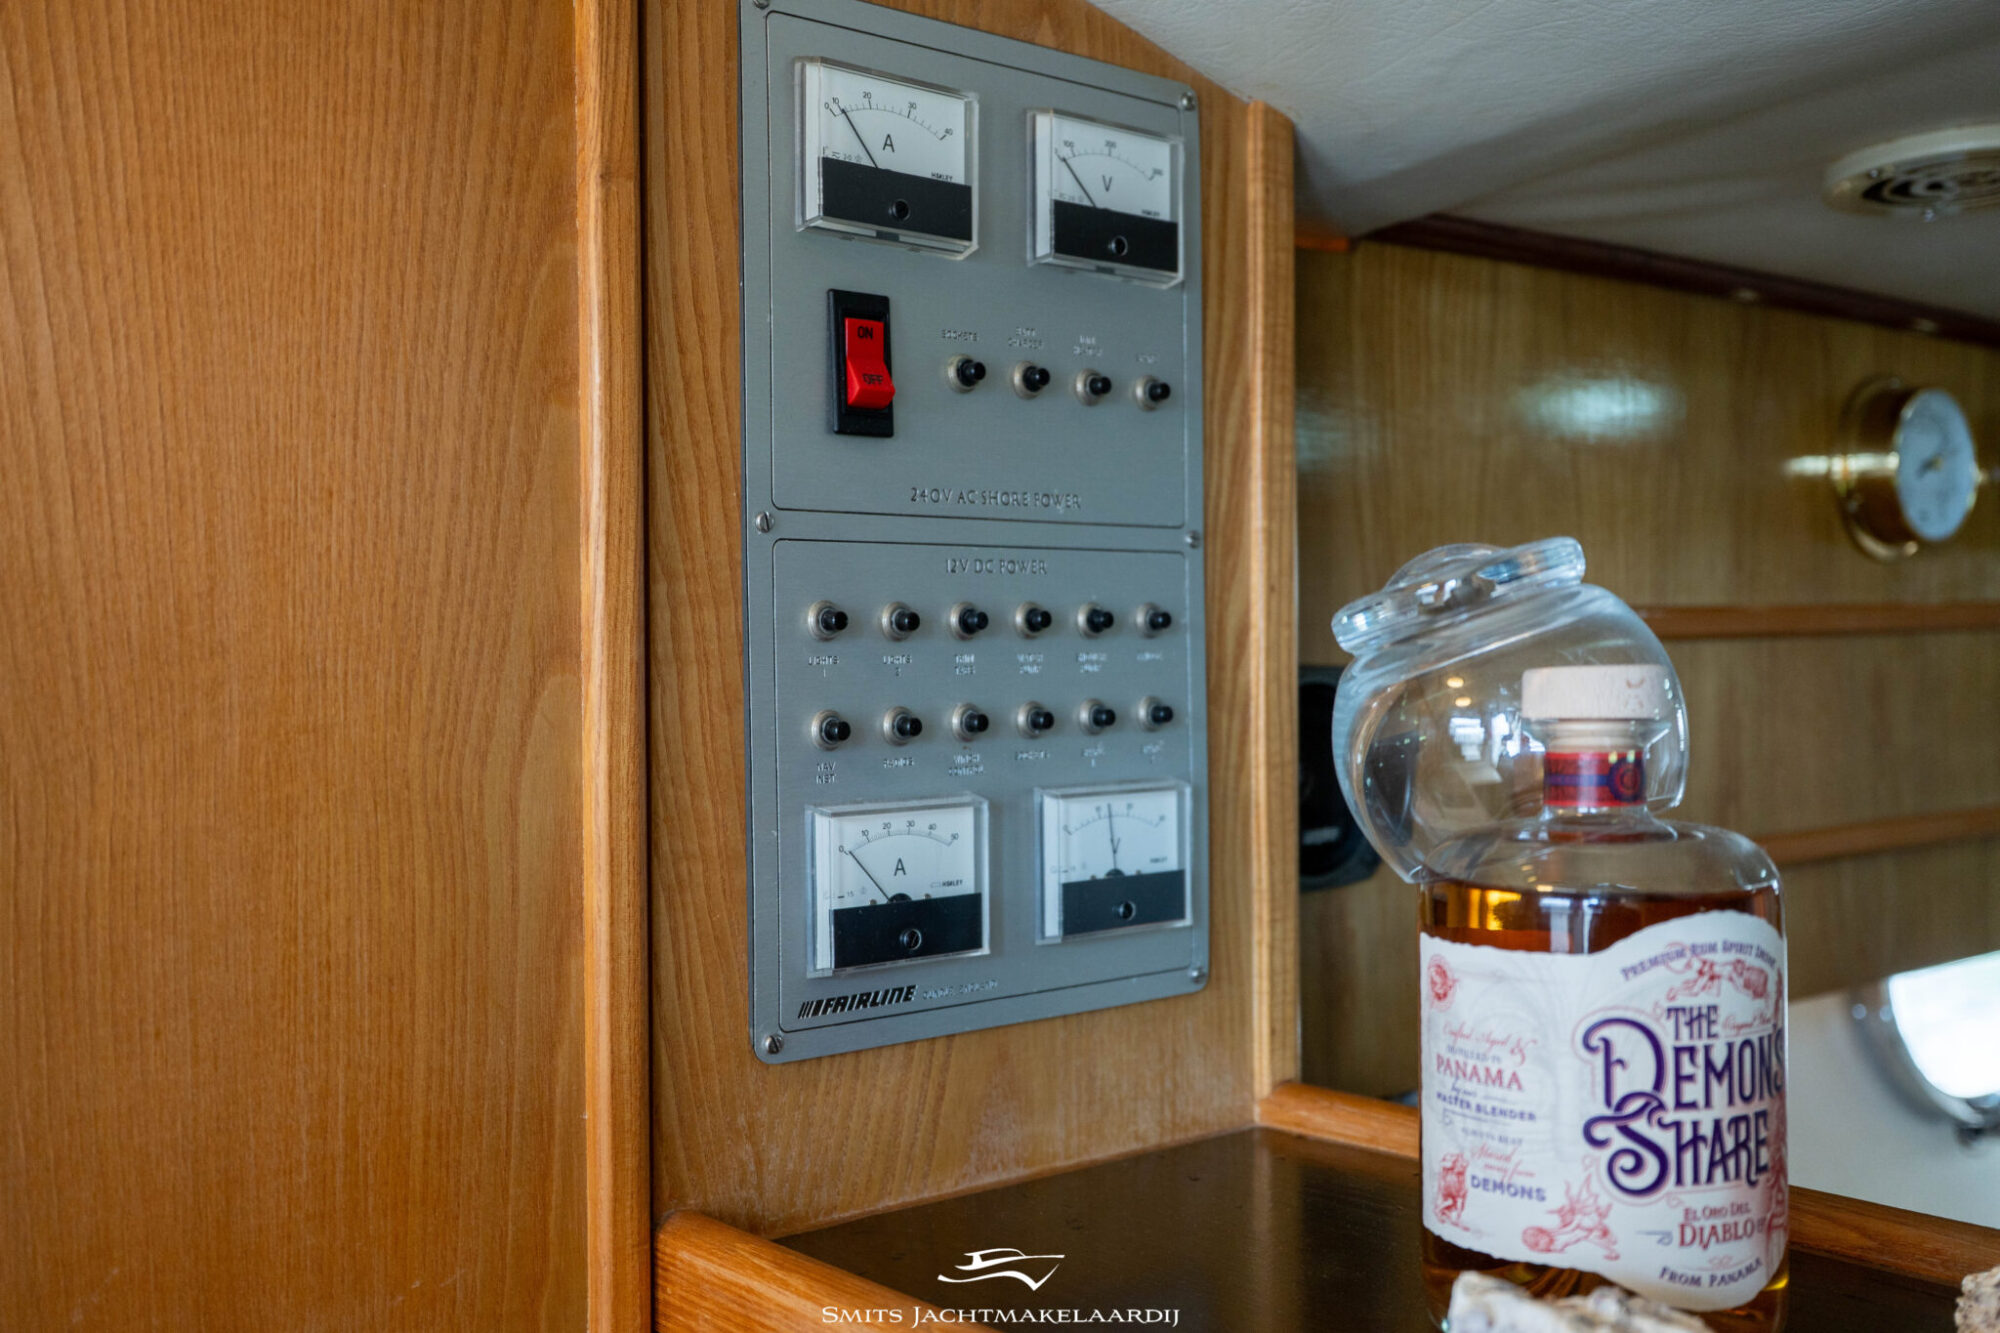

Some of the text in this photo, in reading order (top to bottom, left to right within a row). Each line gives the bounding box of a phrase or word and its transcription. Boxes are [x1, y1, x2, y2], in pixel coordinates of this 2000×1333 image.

[862, 91, 872, 99] 20
[882, 134, 895, 153] A
[1102, 174, 1113, 192] V
[857, 326, 873, 339] ON
[863, 373, 884, 385] OFF
[910, 487, 1082, 509] 240V AC SHORE POWER
[946, 558, 1048, 575] 12V DC POWER
[808, 655, 840, 666] LIGHTS
[816, 760, 837, 773] NAV
[861, 829, 869, 837] 10
[882, 822, 892, 830] 20
[906, 820, 915, 828] 30
[894, 858, 906, 877] A
[1666, 1004, 1719, 1041] THE
[1436, 1052, 1524, 1091] PANAMA
[1437, 1091, 1537, 1122] MASTER BLENDER
[1583, 1092, 1769, 1197] SHARE
[1471, 1174, 1547, 1202] DEMONS
[1678, 1217, 1756, 1251] DIABLO
[1659, 1256, 1763, 1288] FROM PANAMA
